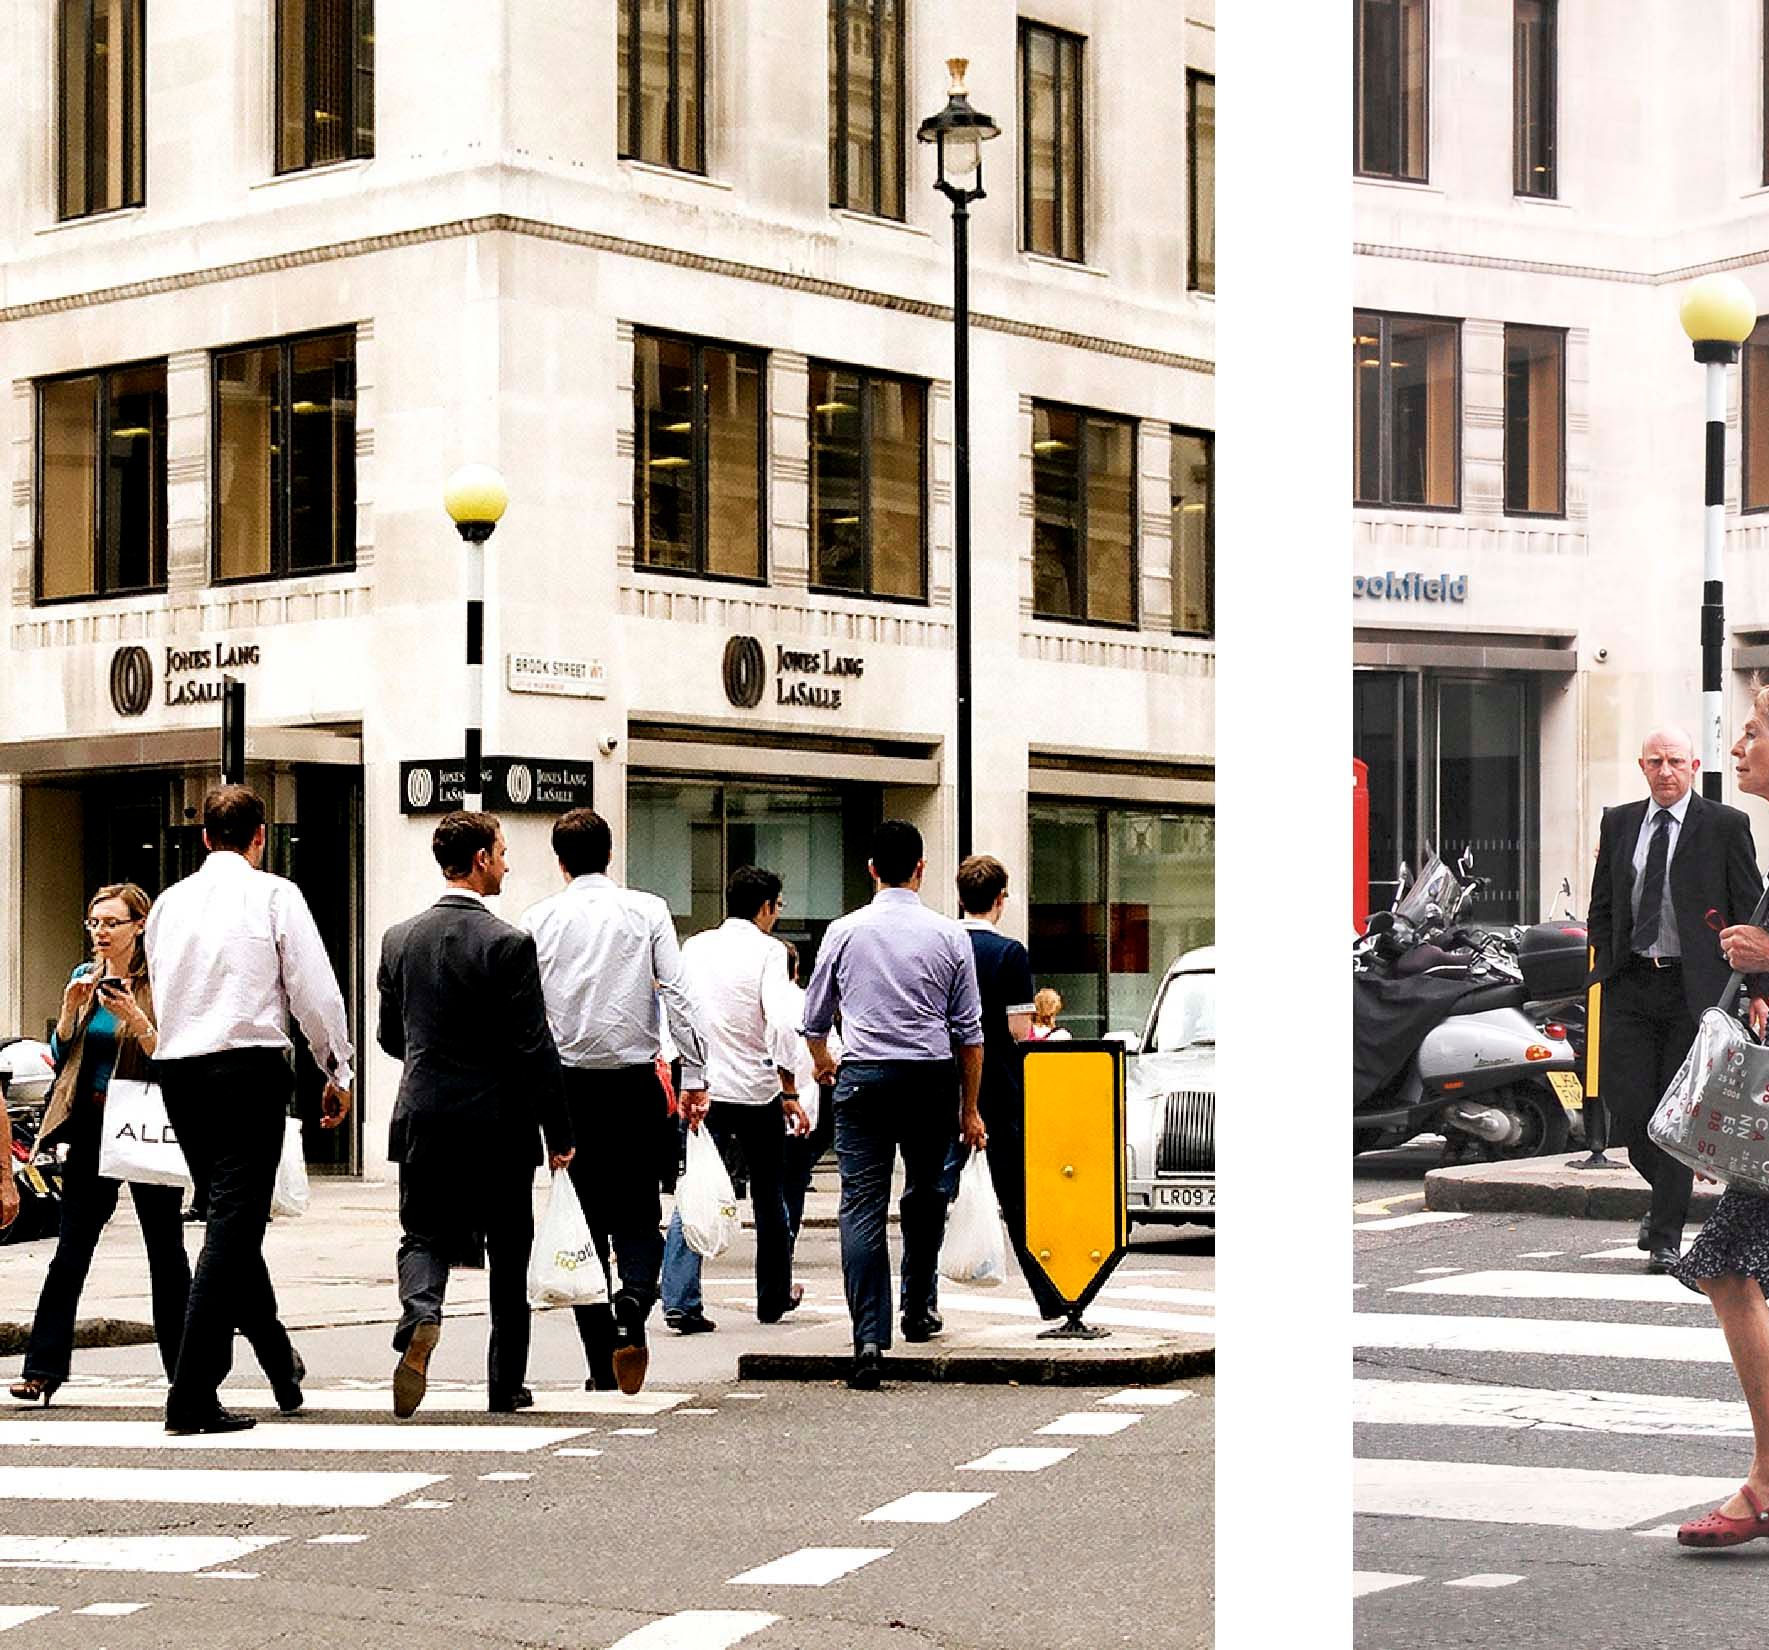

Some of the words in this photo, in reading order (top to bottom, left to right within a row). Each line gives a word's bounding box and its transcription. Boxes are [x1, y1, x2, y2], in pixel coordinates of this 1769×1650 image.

[515, 658, 550, 674] BROOK
[552, 661, 587, 679] STREET
[115, 1122, 178, 1143] ALD
[1160, 1189, 1204, 1206] LR09
